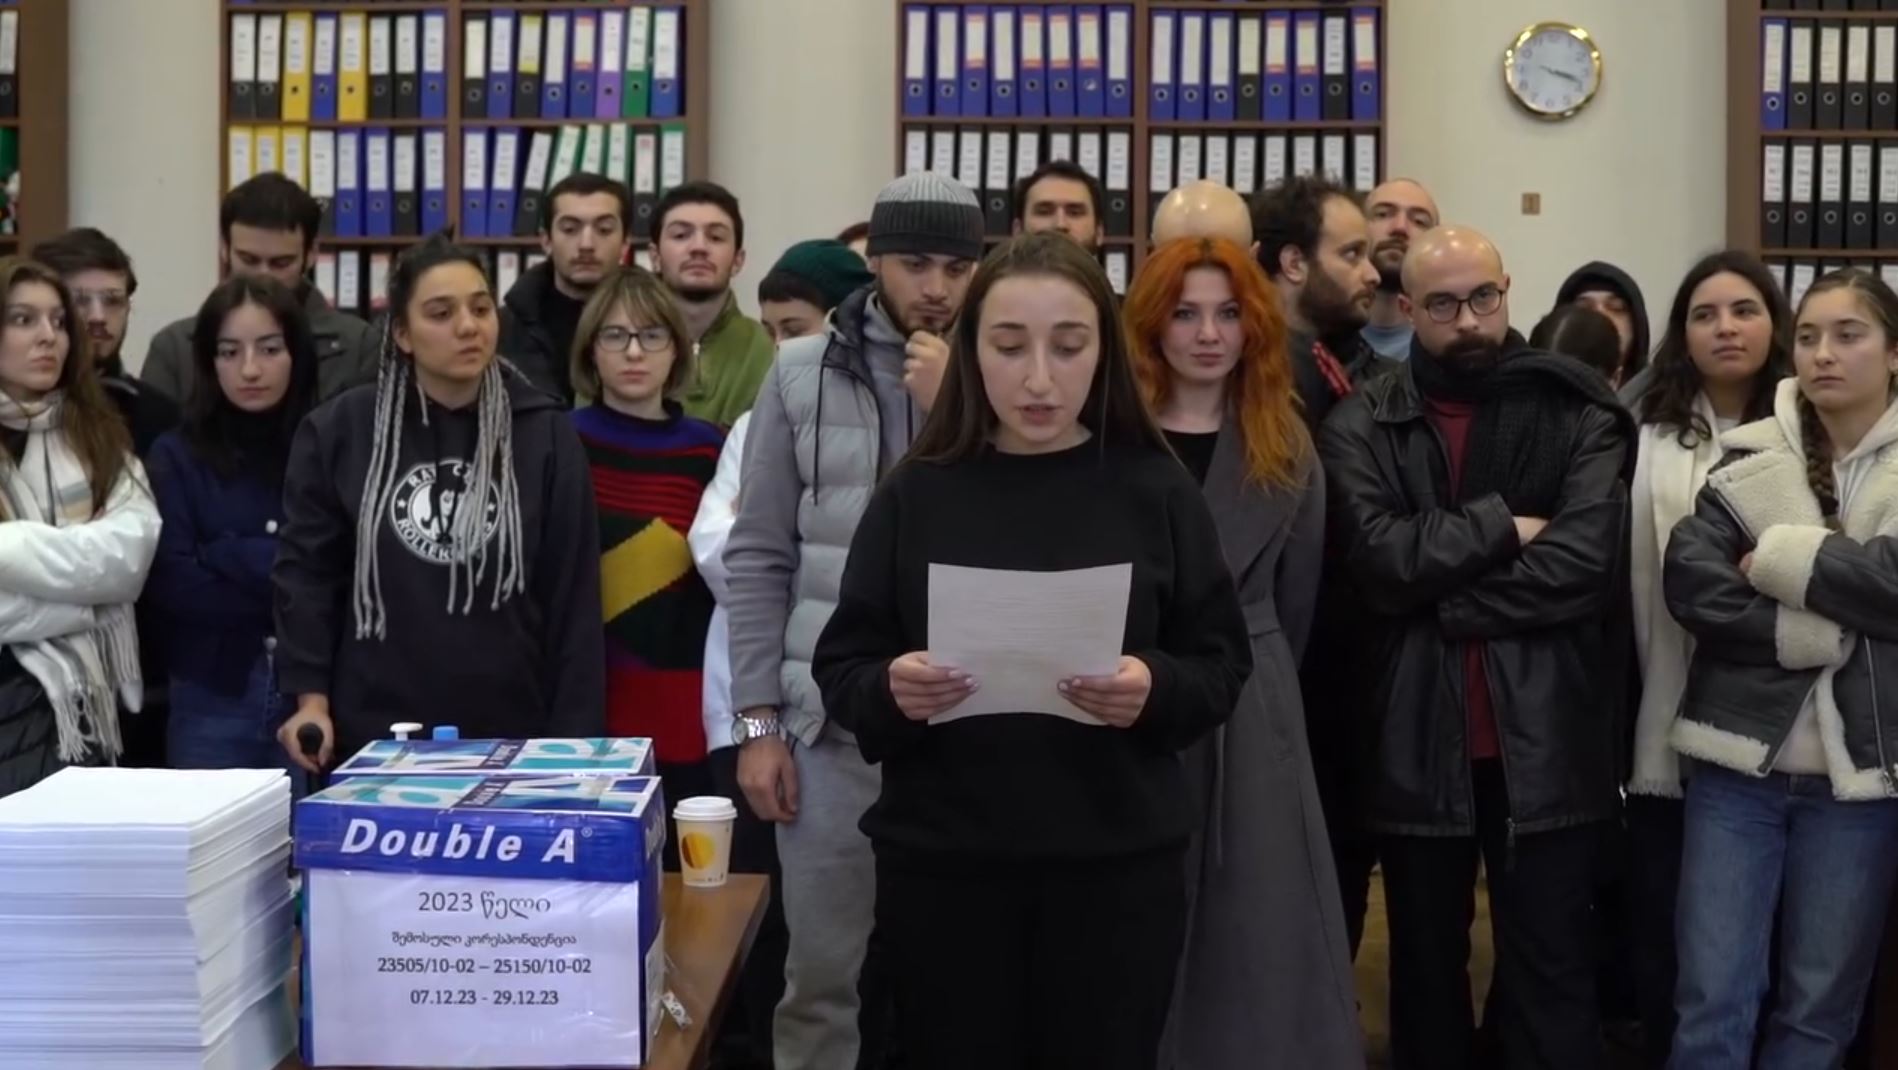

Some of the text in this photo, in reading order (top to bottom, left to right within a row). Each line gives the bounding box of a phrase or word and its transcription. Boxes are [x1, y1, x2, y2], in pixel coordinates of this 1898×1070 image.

[340, 818, 576, 864] Double A
[418, 890, 551, 919] 2023 წელი
[391, 931, 577, 948] შემოსული კორესპონდენცია
[377, 957, 475, 973] 23505/10-02
[493, 958, 592, 974] 25150/10-02
[410, 989, 477, 1005] 07.12.23
[493, 990, 559, 1005] 29.12.23
